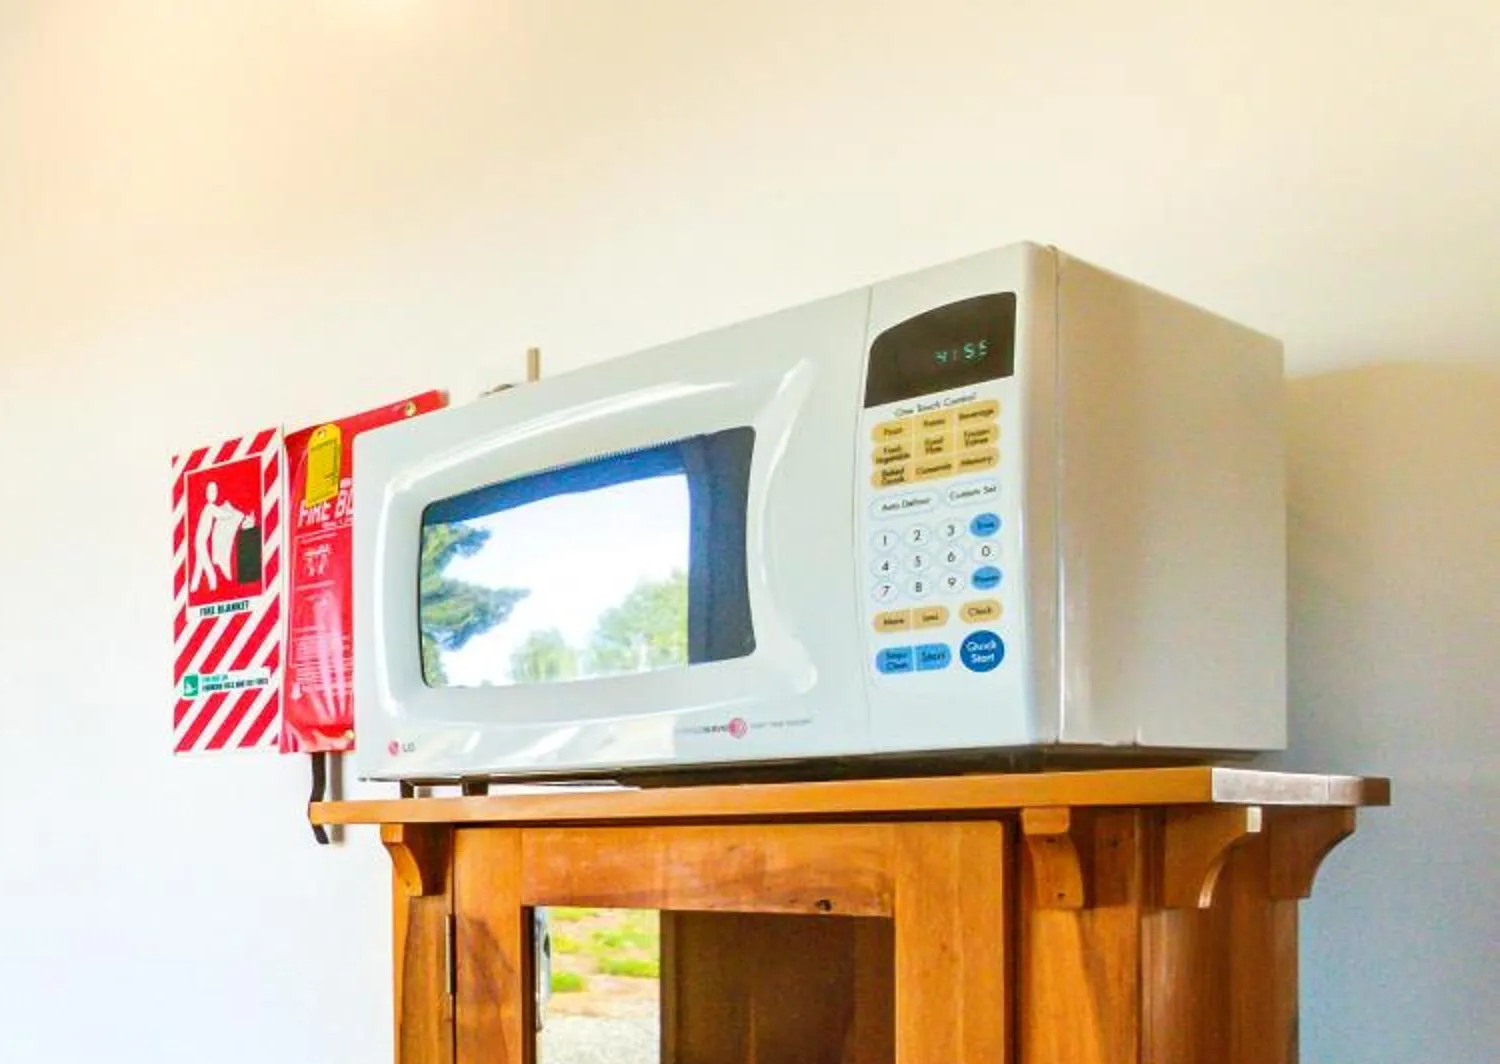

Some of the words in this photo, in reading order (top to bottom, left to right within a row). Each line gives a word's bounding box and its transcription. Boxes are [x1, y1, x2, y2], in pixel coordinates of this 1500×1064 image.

[913, 529, 922, 542] 2
[947, 524, 956, 537] 3
[881, 560, 890, 571] 4
[914, 555, 922, 569] 5
[947, 551, 957, 563] 6
[981, 545, 991, 557] 0
[883, 585, 892, 597] 7
[915, 581, 923, 593] 8
[947, 577, 957, 588] 9
[970, 652, 996, 665] Start
